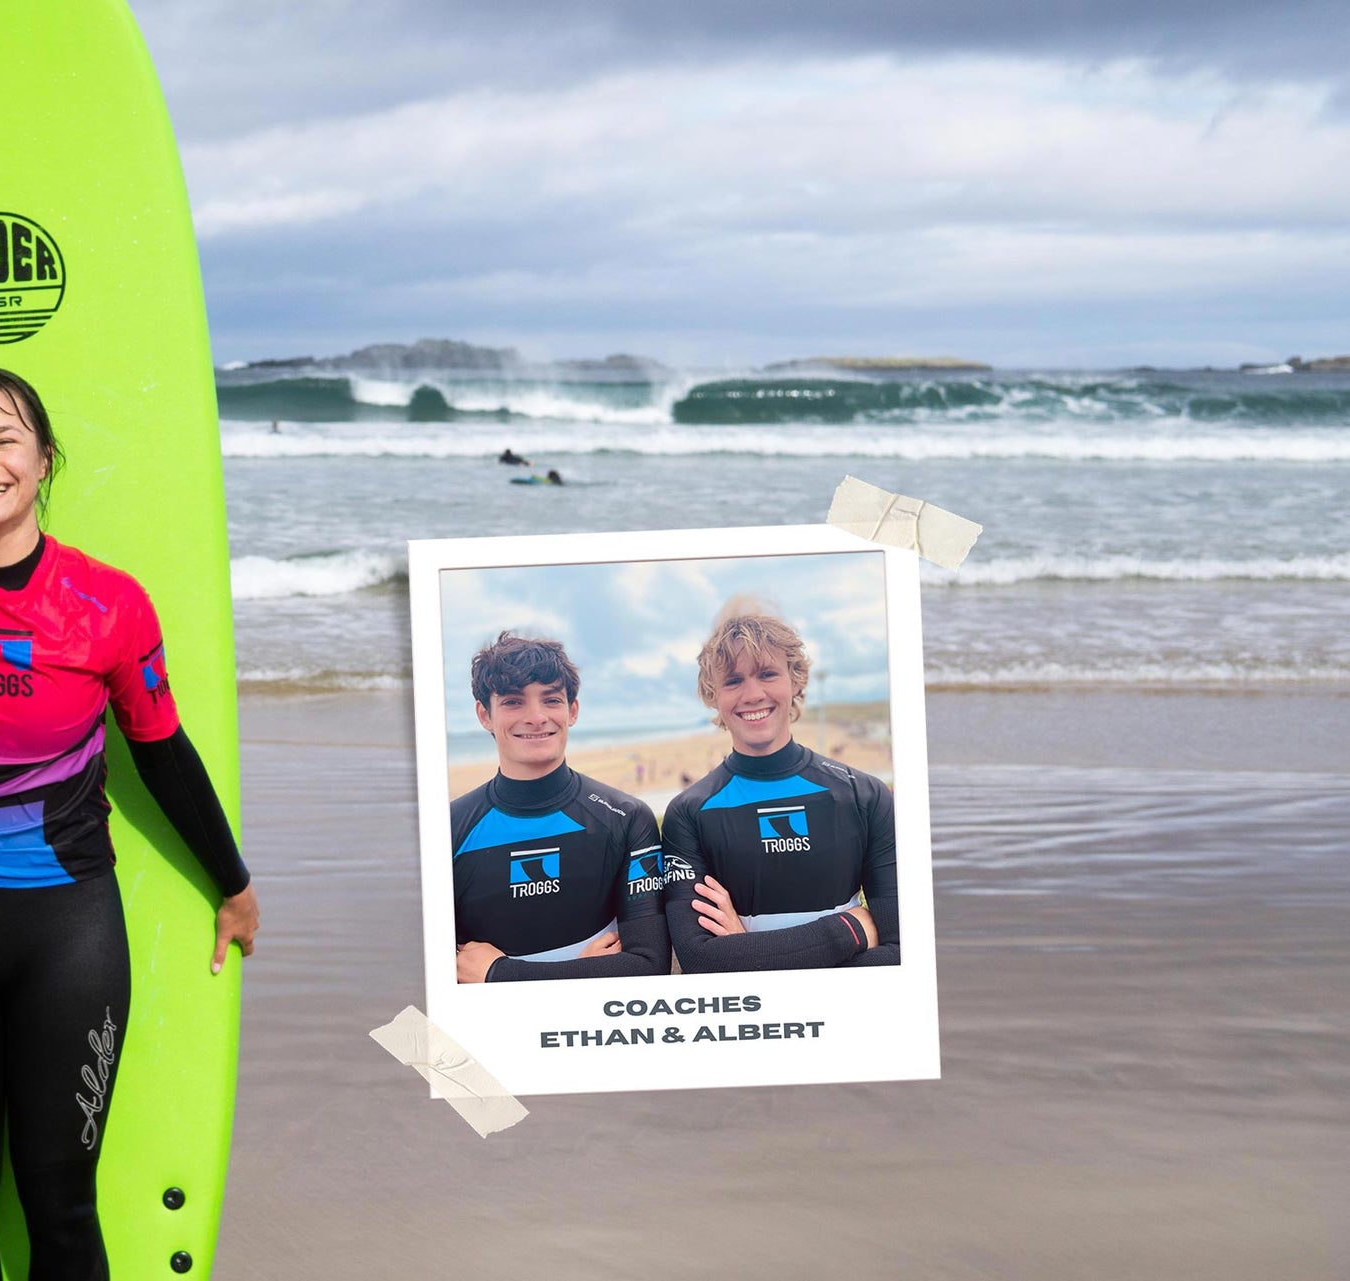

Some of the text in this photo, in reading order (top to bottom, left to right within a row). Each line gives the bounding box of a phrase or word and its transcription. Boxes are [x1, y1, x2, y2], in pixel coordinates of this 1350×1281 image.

[761, 837, 811, 854] TROGGS
[509, 878, 561, 899] TROGGS
[75, 1005, 118, 1151] Alder
